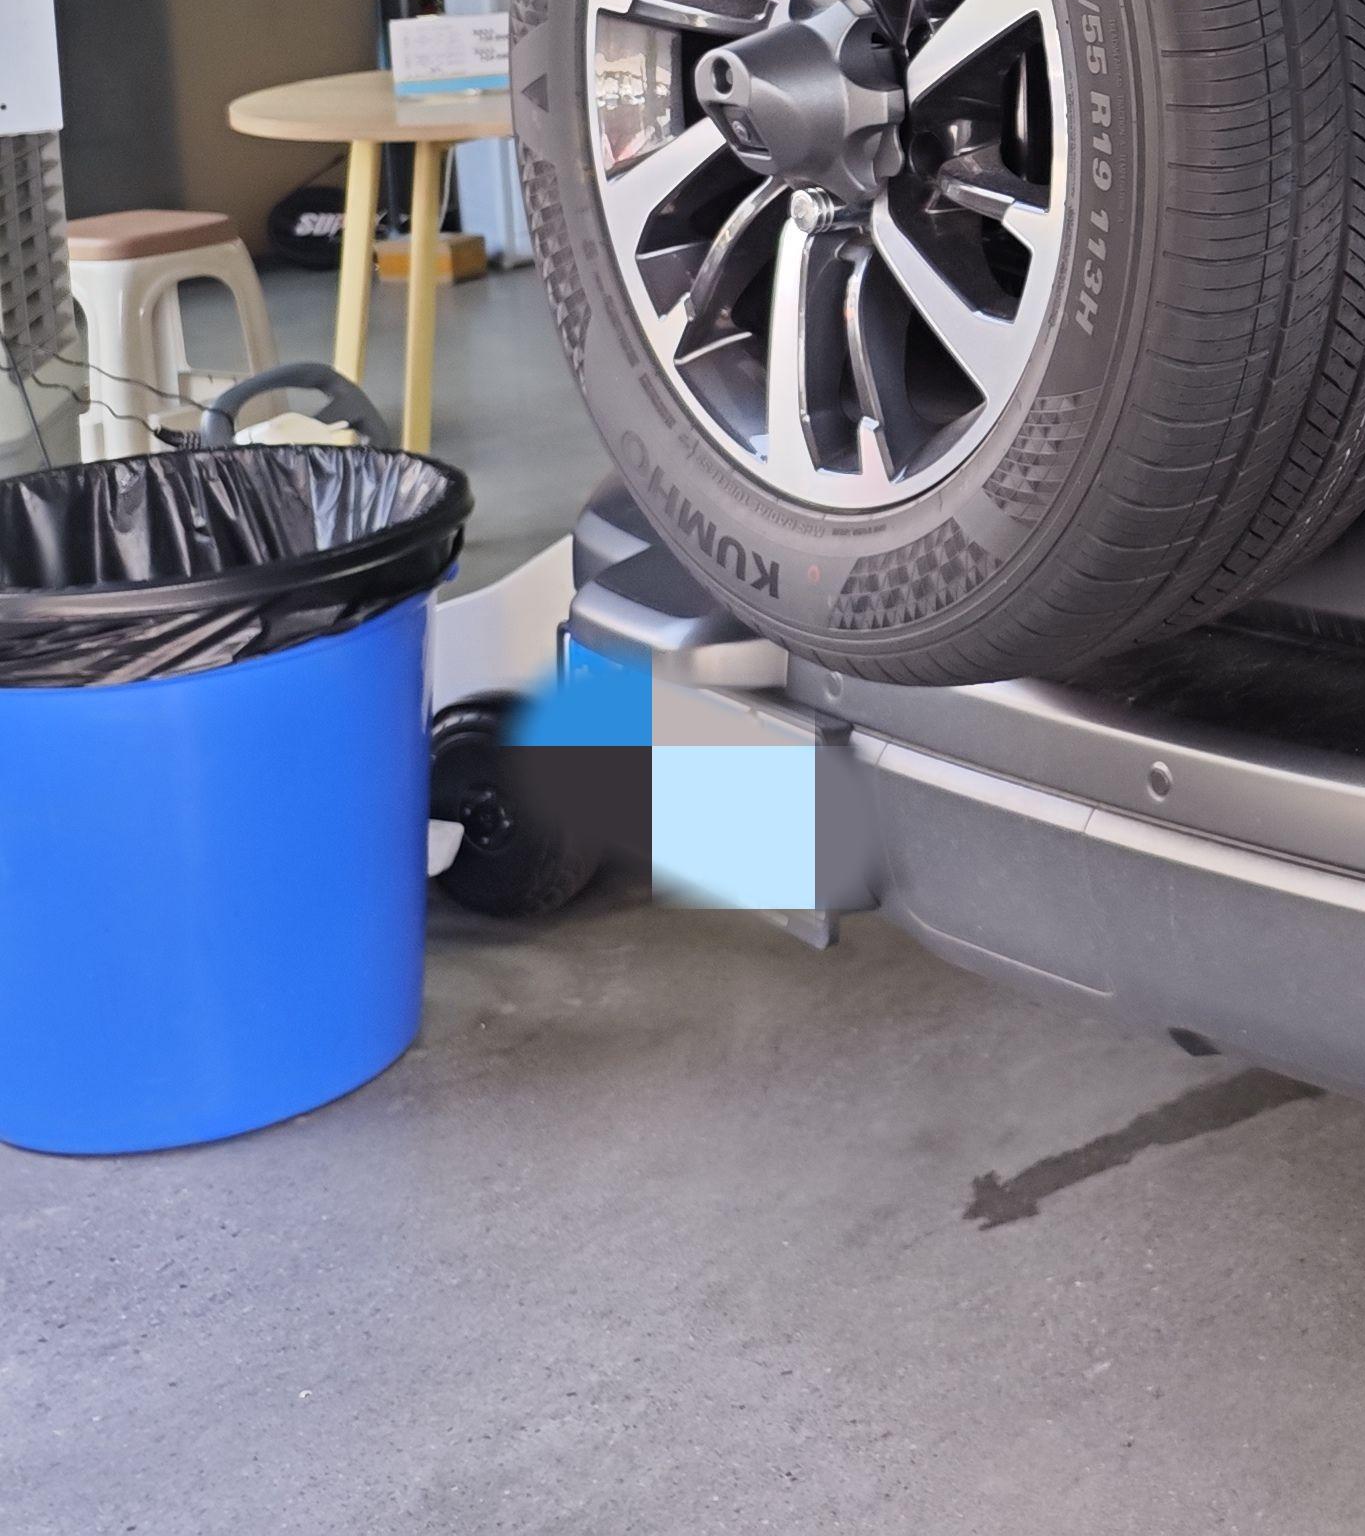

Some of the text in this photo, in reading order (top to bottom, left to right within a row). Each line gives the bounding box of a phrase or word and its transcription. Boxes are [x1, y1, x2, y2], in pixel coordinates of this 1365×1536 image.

[1090, 91, 1112, 191] R19
[1075, 209, 1109, 336] 113H
[621, 429, 780, 599] KUMHO
